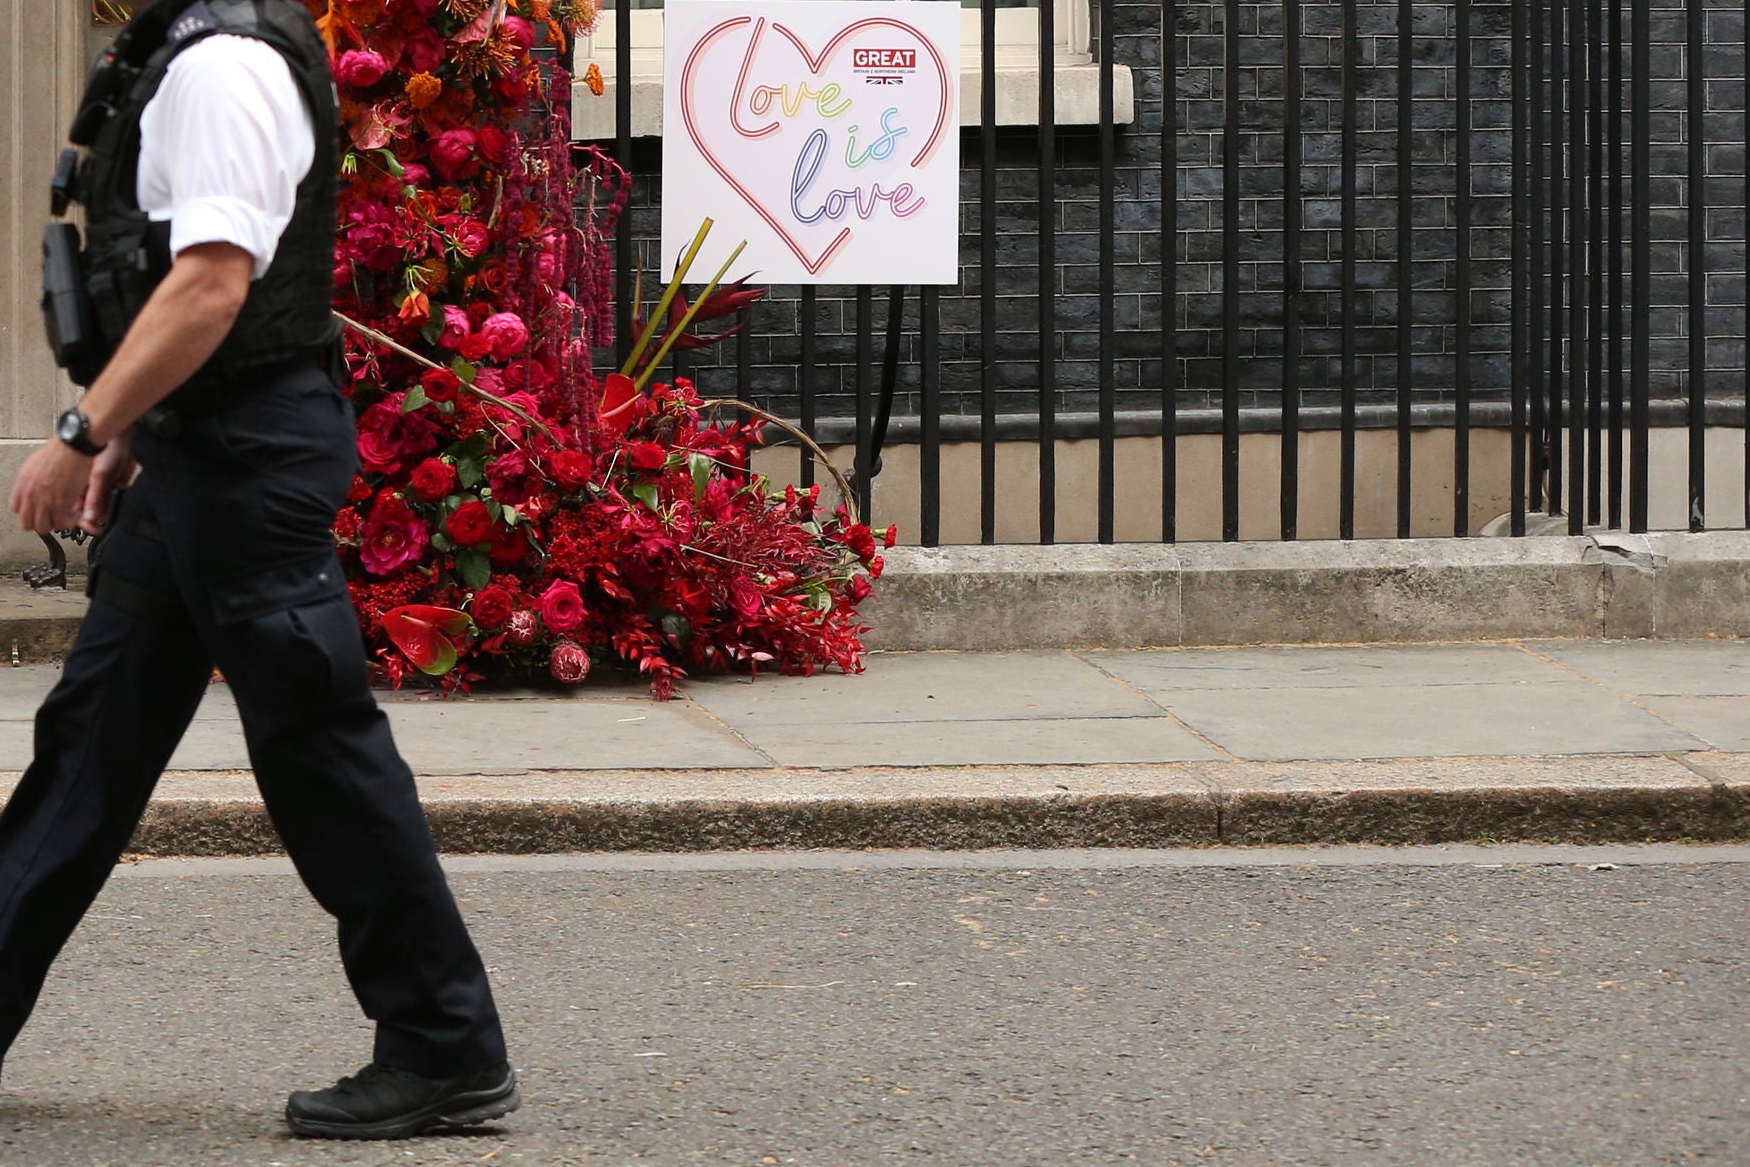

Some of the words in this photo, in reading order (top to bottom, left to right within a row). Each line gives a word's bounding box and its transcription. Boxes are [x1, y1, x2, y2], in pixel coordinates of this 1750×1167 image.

[729, 17, 853, 138] Love
[855, 50, 914, 66] GREAT
[790, 128, 925, 223] love
[845, 107, 907, 168] is
